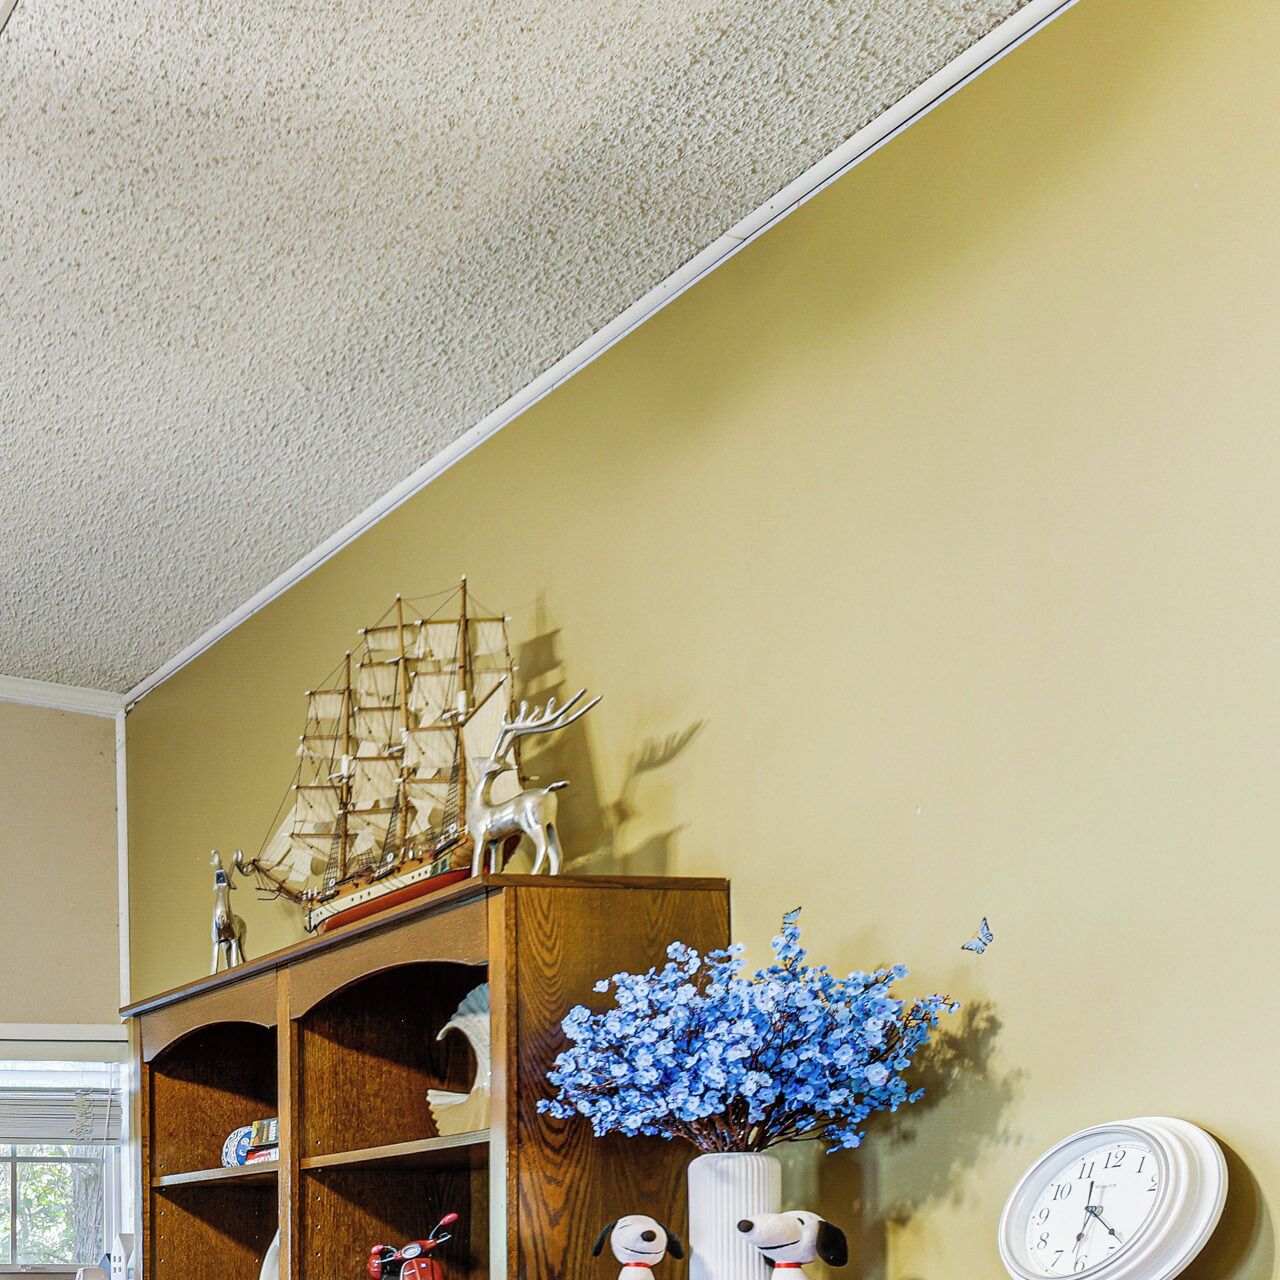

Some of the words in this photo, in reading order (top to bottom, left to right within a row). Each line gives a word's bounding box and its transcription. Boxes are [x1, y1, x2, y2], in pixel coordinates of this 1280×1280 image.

[1101, 1150, 1126, 1169] 12
[1136, 1156, 1146, 1174] 1
[1077, 1162, 1095, 1180] 11
[1052, 1182, 1072, 1202] 10
[1037, 1207, 1050, 1225] 9
[1036, 1232, 1050, 1250] 8
[1050, 1250, 1064, 1268] 7
[1073, 1254, 1088, 1273] 6
